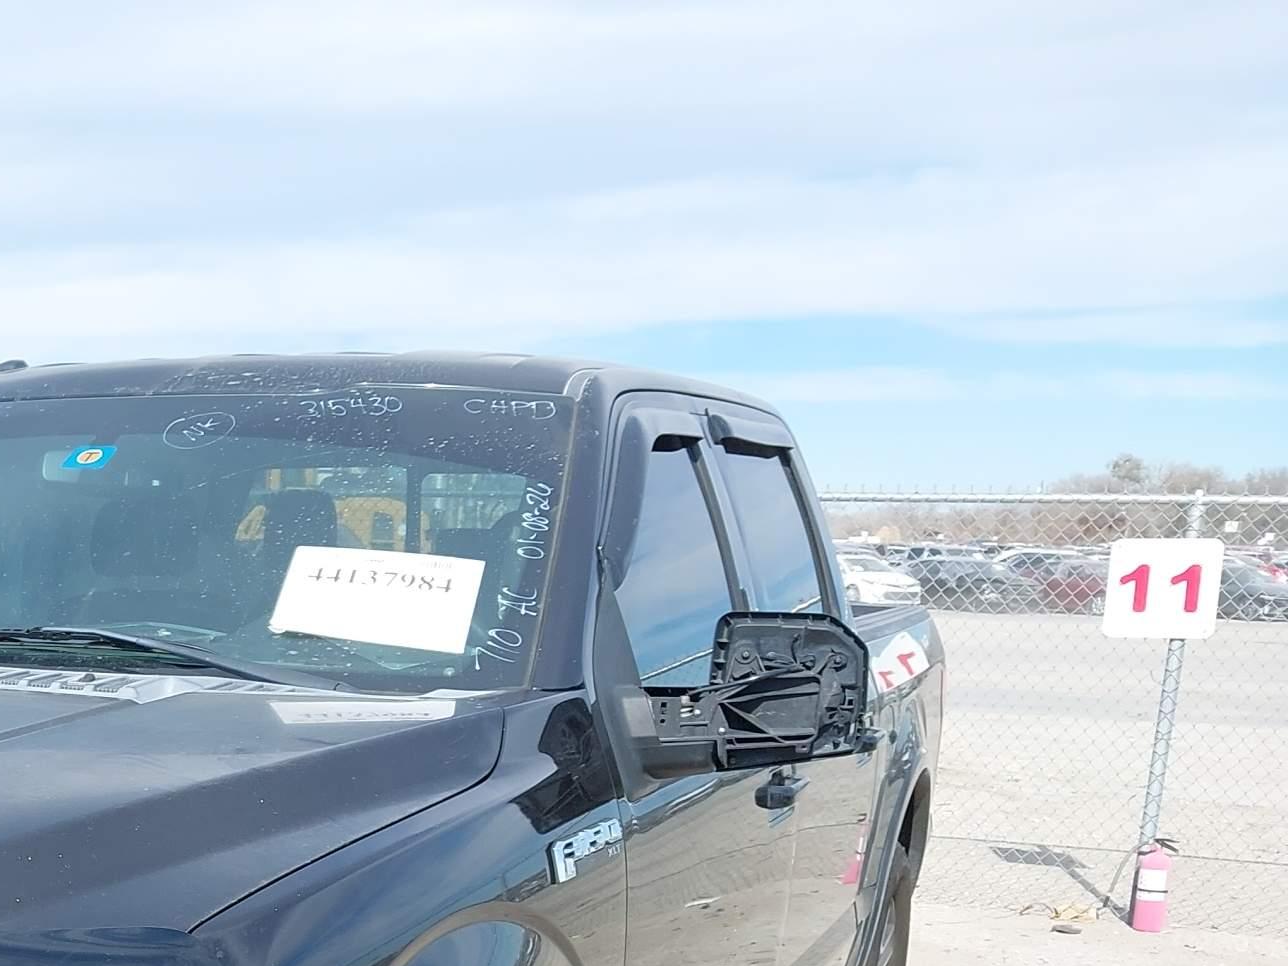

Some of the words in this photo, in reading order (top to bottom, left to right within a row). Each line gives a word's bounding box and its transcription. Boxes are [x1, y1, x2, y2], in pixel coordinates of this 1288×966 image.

[299, 395, 403, 418] 315430
[308, 567, 453, 592] 44137984
[1119, 564, 1202, 613] 11
[475, 628, 522, 671] 710
